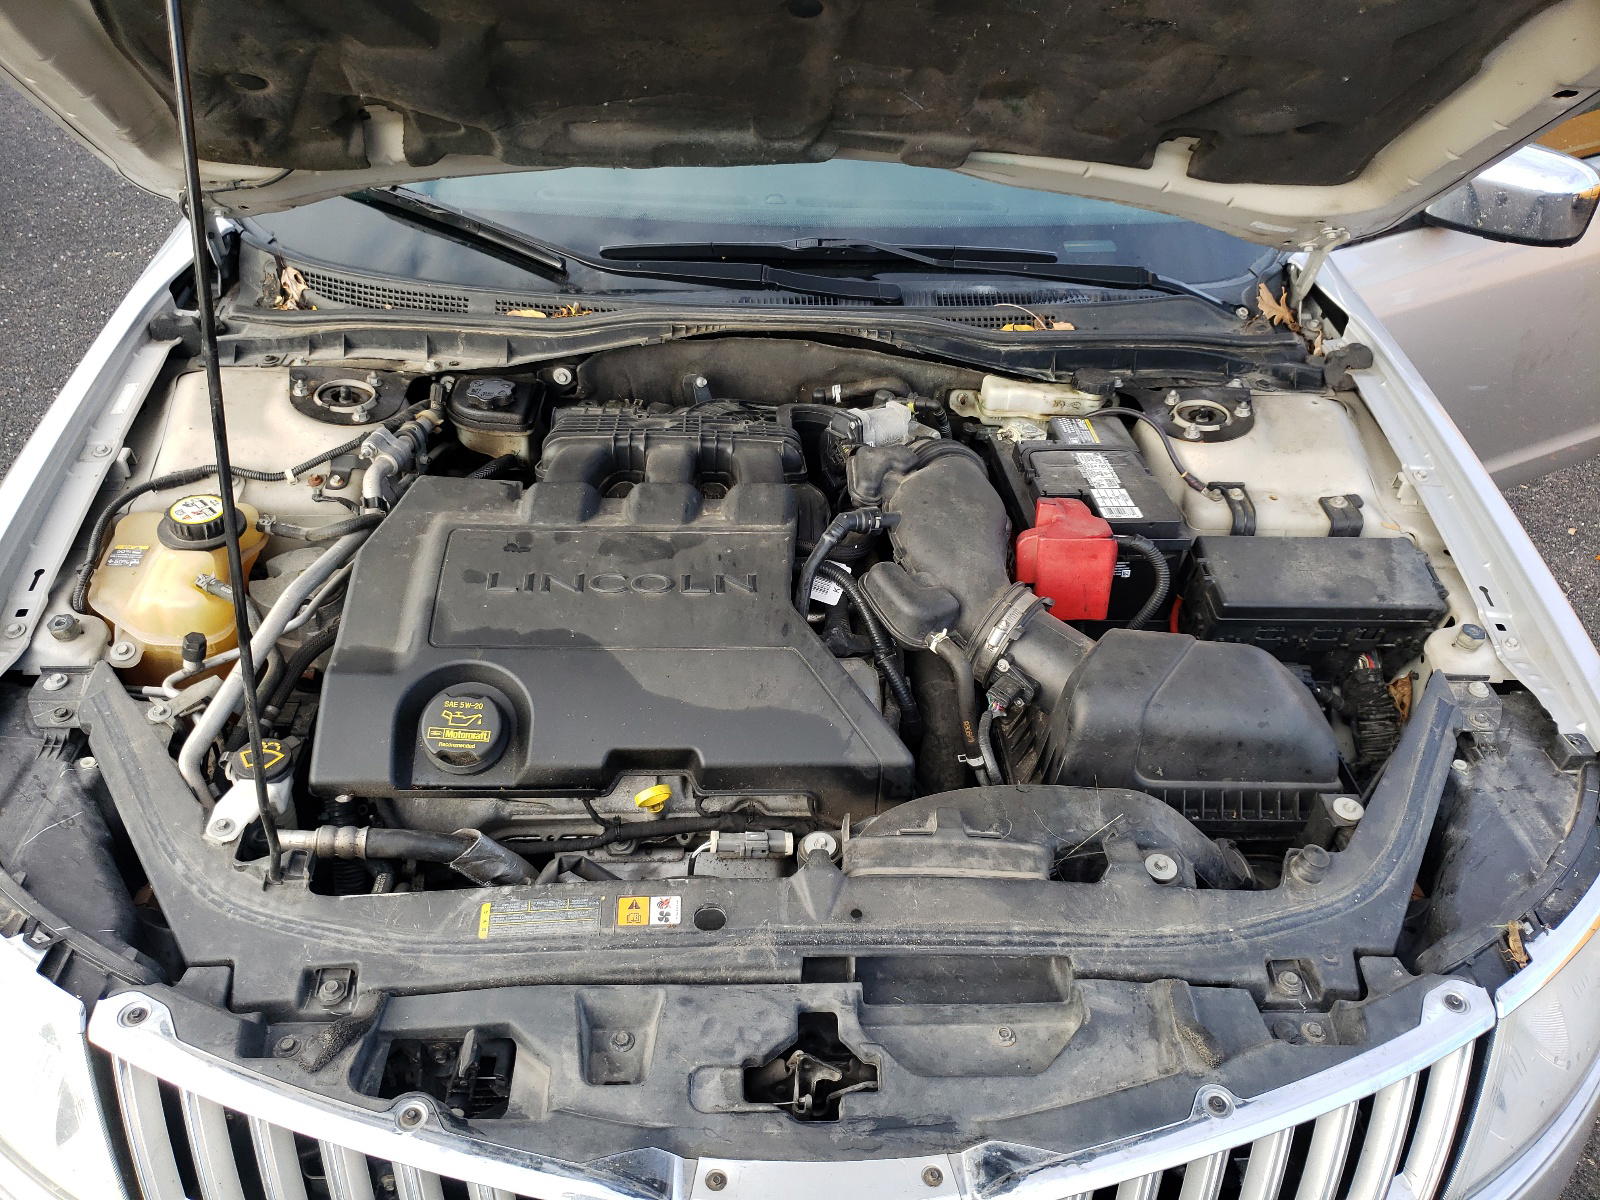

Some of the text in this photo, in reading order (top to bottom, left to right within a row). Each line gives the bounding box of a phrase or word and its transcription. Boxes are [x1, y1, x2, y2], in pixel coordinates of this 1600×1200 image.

[486, 572, 758, 595] LINCOLN
[444, 700, 484, 710] SAE 5W-20
[445, 730, 488, 741] Motorcraft
